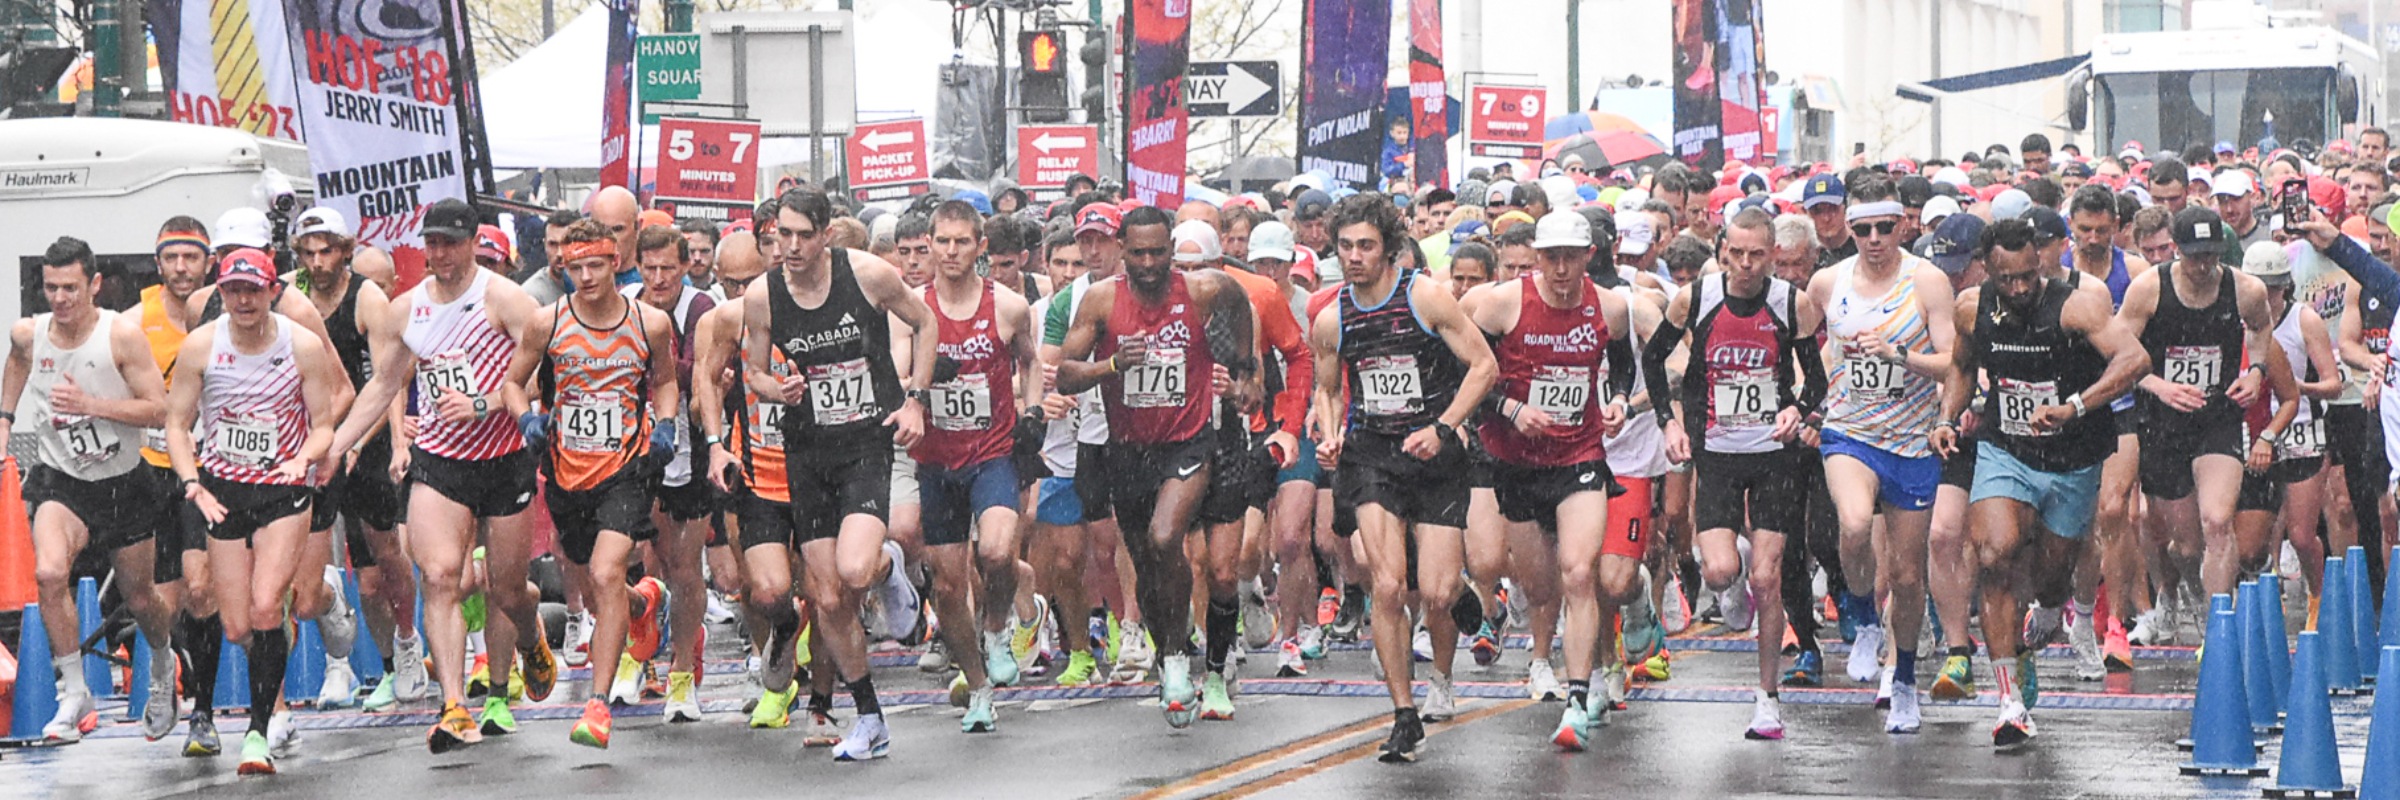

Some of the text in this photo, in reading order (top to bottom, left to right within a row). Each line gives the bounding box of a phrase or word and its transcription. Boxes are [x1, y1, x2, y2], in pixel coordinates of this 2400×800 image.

[305, 28, 384, 94] HOF
[325, 89, 446, 136] JERRY SMITH
[1479, 93, 1539, 118] 7 to 9
[1336, 109, 1371, 138] NOLAN
[668, 129, 753, 163] 5 to 7
[861, 151, 914, 168] PACKET
[317, 150, 455, 198] MOUNTAIN
[680, 169, 736, 183] MINUTES
[862, 165, 917, 181] PICK-UP
[1037, 157, 1079, 169] RELAY
[5, 171, 78, 187] Haulmark
[358, 184, 420, 219] GOAT
[807, 325, 861, 346] CABADA
[1713, 346, 1767, 368] GVH
[427, 366, 468, 399] 875
[1135, 365, 1178, 393] 176
[1369, 372, 1413, 395] 1322
[1851, 360, 1893, 389] 537
[2172, 359, 2213, 386] 251
[818, 376, 865, 409] 347
[945, 390, 976, 418] 56
[1540, 385, 1583, 408] 1240
[1729, 384, 1762, 414] 78
[568, 408, 613, 437] 431
[68, 423, 102, 455] 51
[227, 427, 270, 453] 1085
